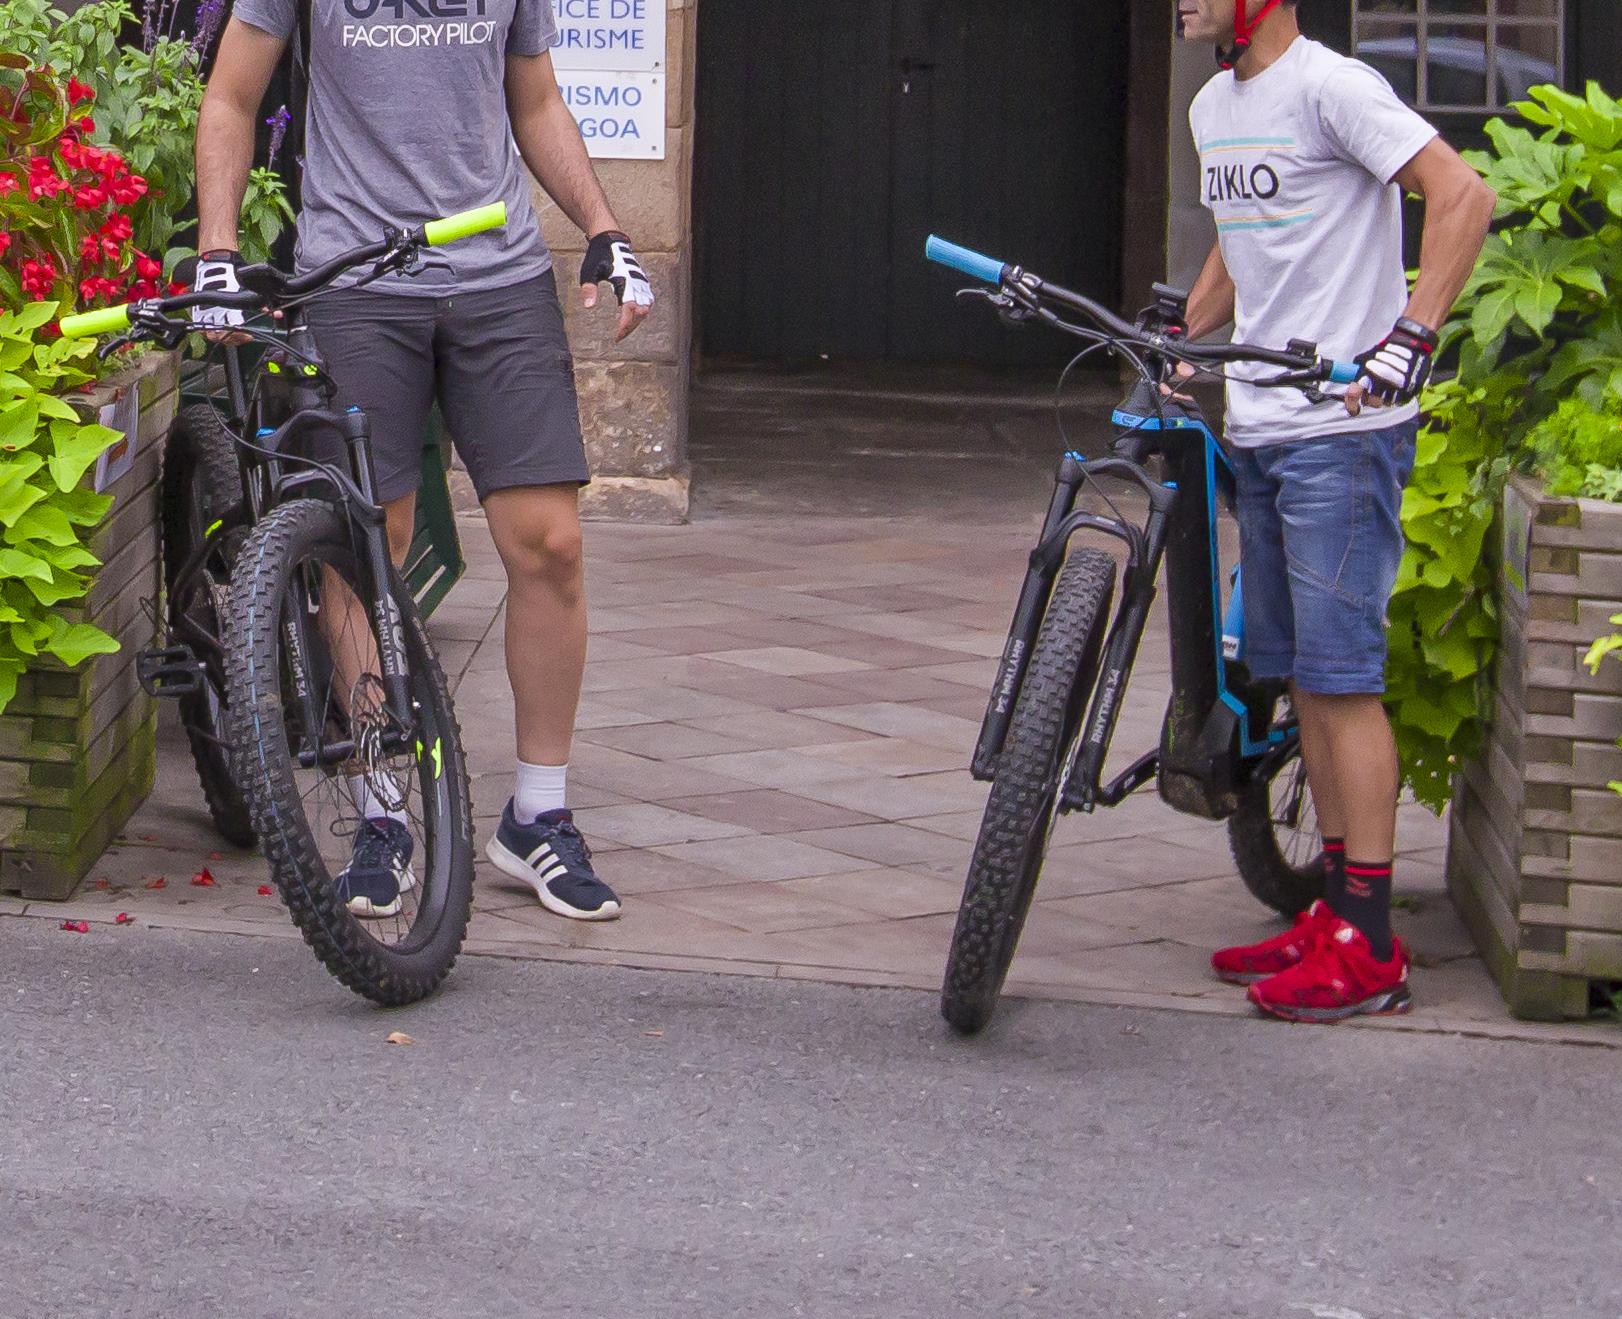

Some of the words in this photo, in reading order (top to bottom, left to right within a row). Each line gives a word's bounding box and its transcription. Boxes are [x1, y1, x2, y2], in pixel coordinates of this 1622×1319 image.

[610, 0, 646, 20] DE
[342, 24, 444, 48] FACTORY
[446, 21, 497, 46] PILOT
[1207, 164, 1280, 201] ZIKLO
